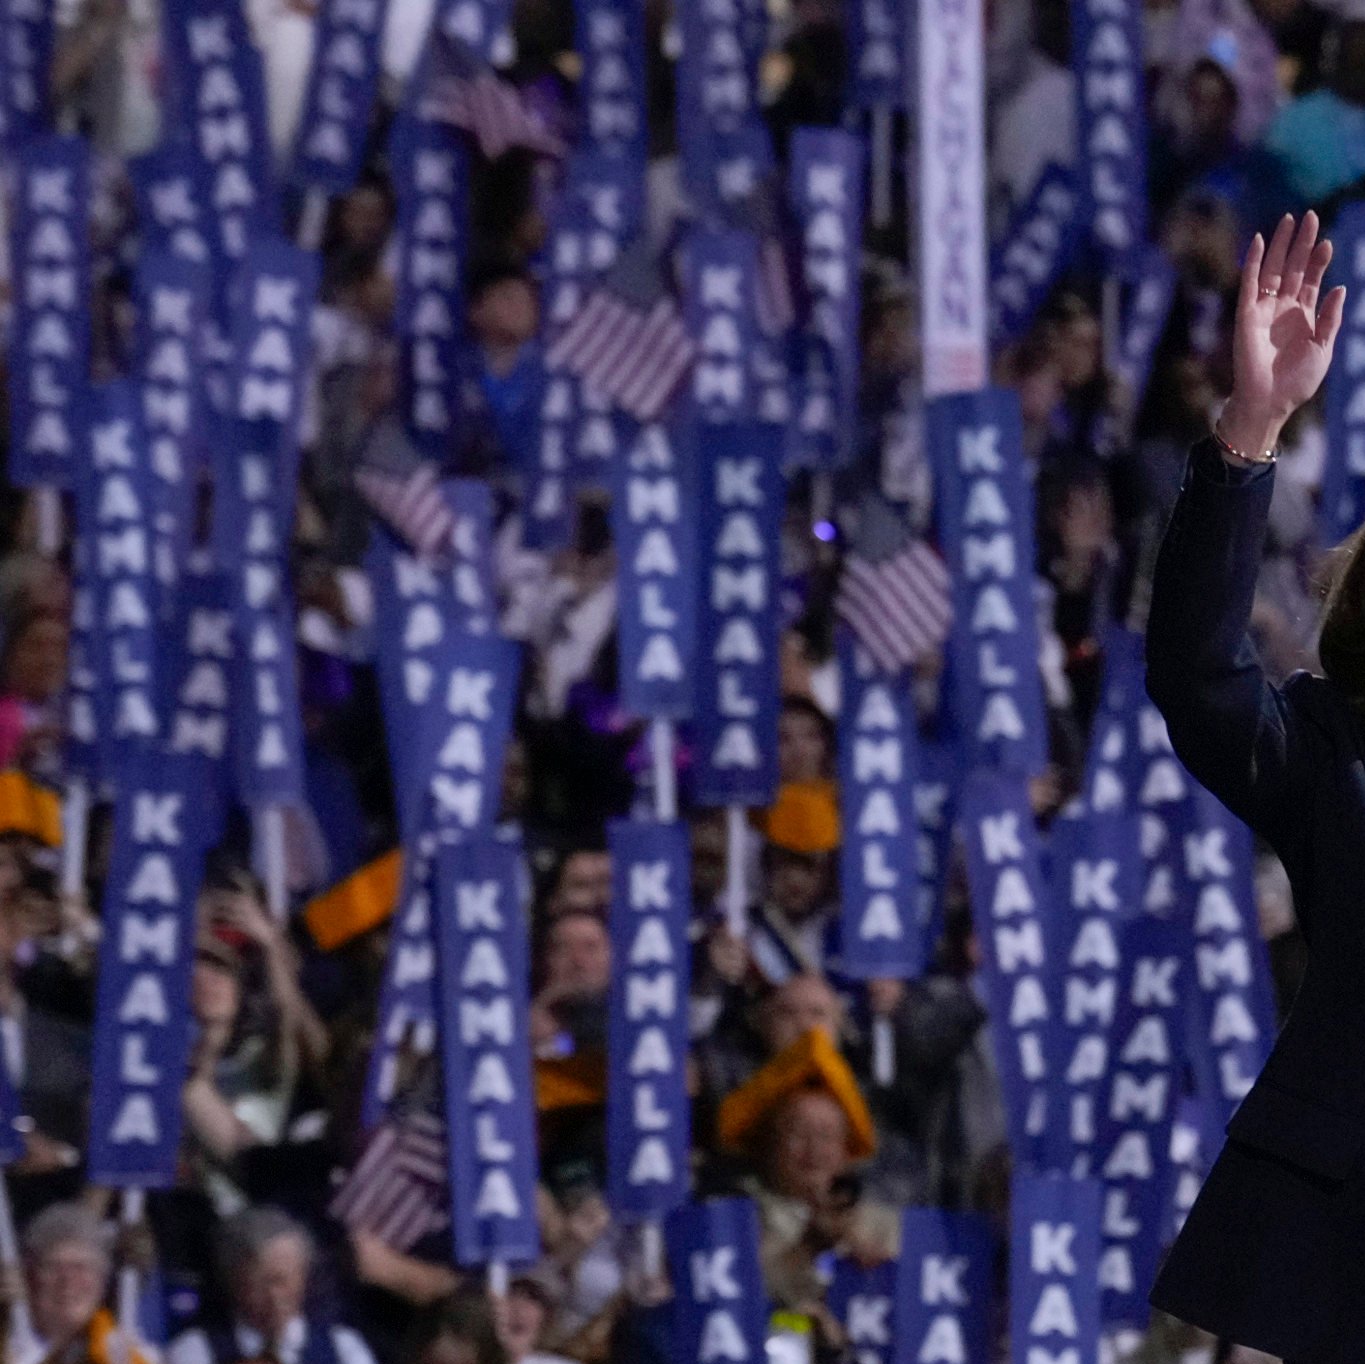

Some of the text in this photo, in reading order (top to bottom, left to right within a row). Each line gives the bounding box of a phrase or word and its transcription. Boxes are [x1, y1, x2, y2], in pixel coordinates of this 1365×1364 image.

[187, 15, 255, 258] KAMAL
[590, 8, 642, 140] KAM
[27, 168, 76, 456] KAMALA
[240, 275, 298, 420] KAM
[696, 265, 744, 402] KAM
[93, 418, 158, 738] KAMALA
[170, 612, 232, 758] KAM
[625, 425, 685, 682] AMALA
[712, 455, 768, 770] KAMALA
[957, 425, 1022, 740] KAMALA
[430, 668, 494, 828] KAM
[852, 685, 902, 940] AMALA
[110, 792, 184, 1146] KAMALA
[450, 880, 520, 1218] KAMALA
[624, 862, 683, 1185] KAMALA
[1182, 826, 1260, 1098] KAMAL
[1096, 955, 1182, 1294] KAMALA
